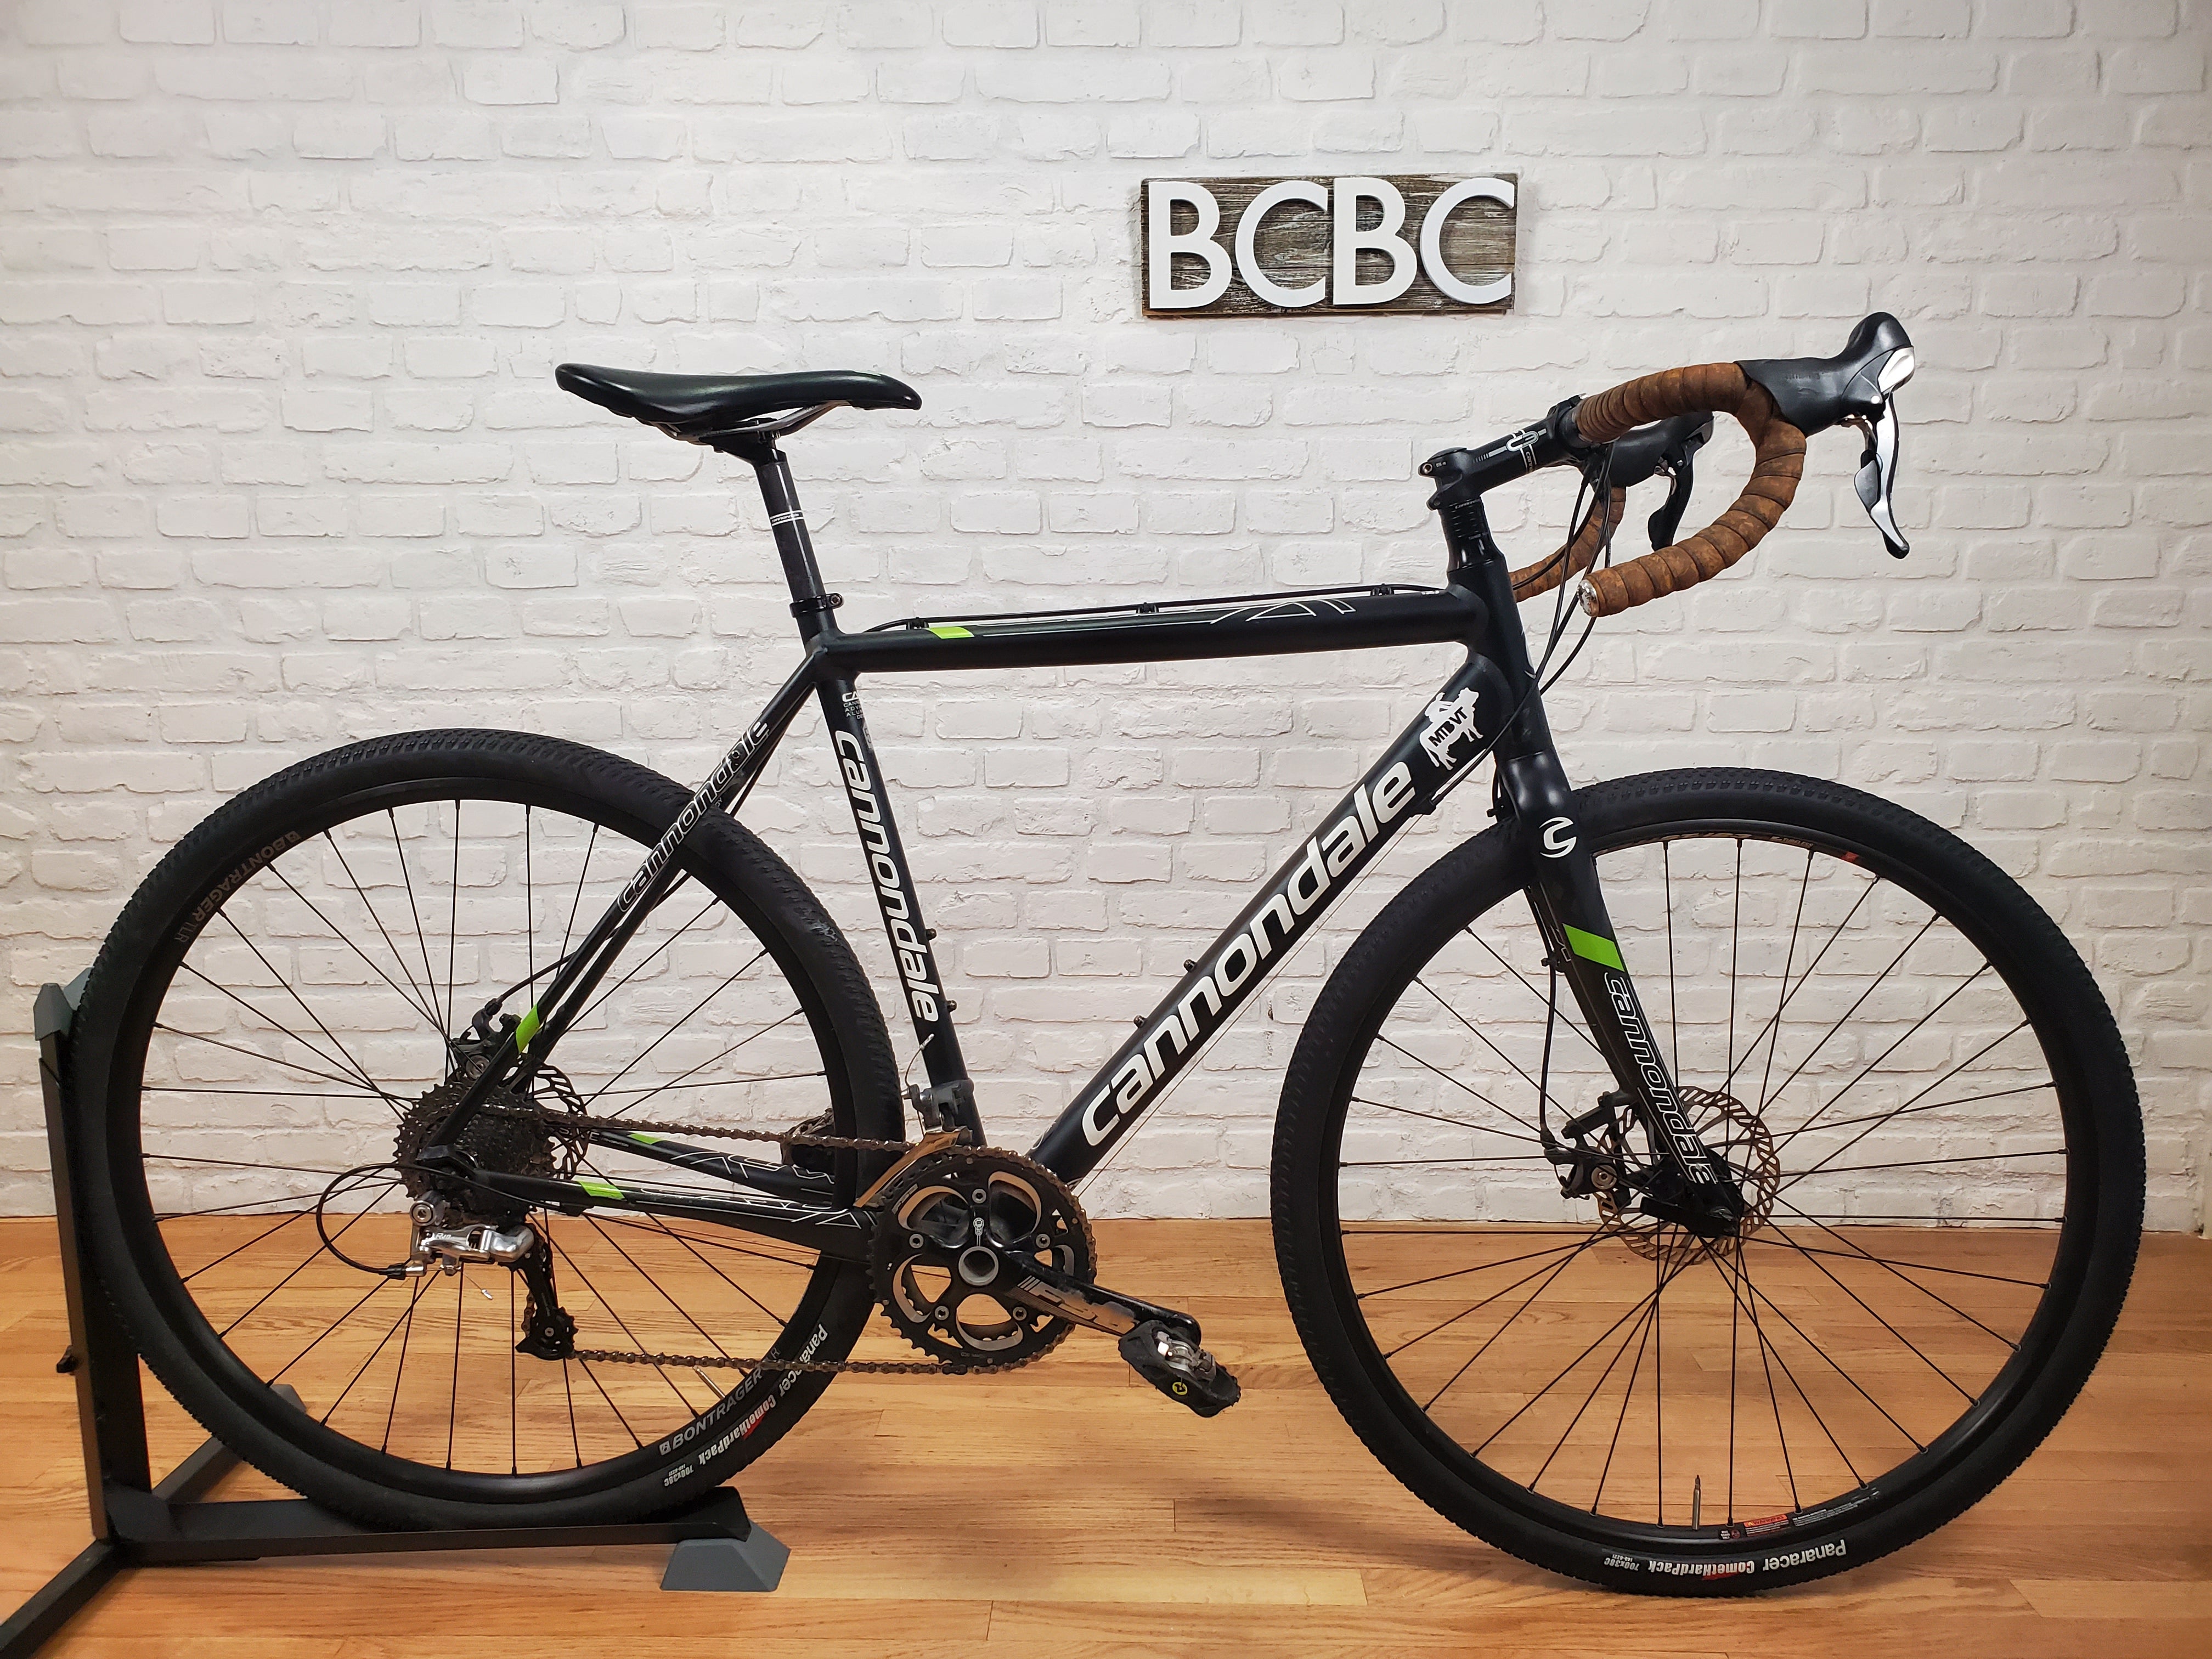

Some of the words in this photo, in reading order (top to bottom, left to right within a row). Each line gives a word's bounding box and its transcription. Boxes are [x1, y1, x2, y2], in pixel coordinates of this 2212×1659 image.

[1148, 177, 1515, 308] BCBC
[618, 721, 769, 912] cannondale
[193, 837, 286, 922] BONTRAGER
[836, 730, 939, 1022] cannondale
[1082, 761, 1415, 1147] cannondale
[1604, 972, 1718, 1184] cannondale
[671, 1363, 763, 1450] BONTRAGER
[1604, 1557, 1640, 1571] 700x38C
[1648, 1560, 1755, 1577] CometHardPack
[1763, 1539, 1847, 1572] Panaracer
